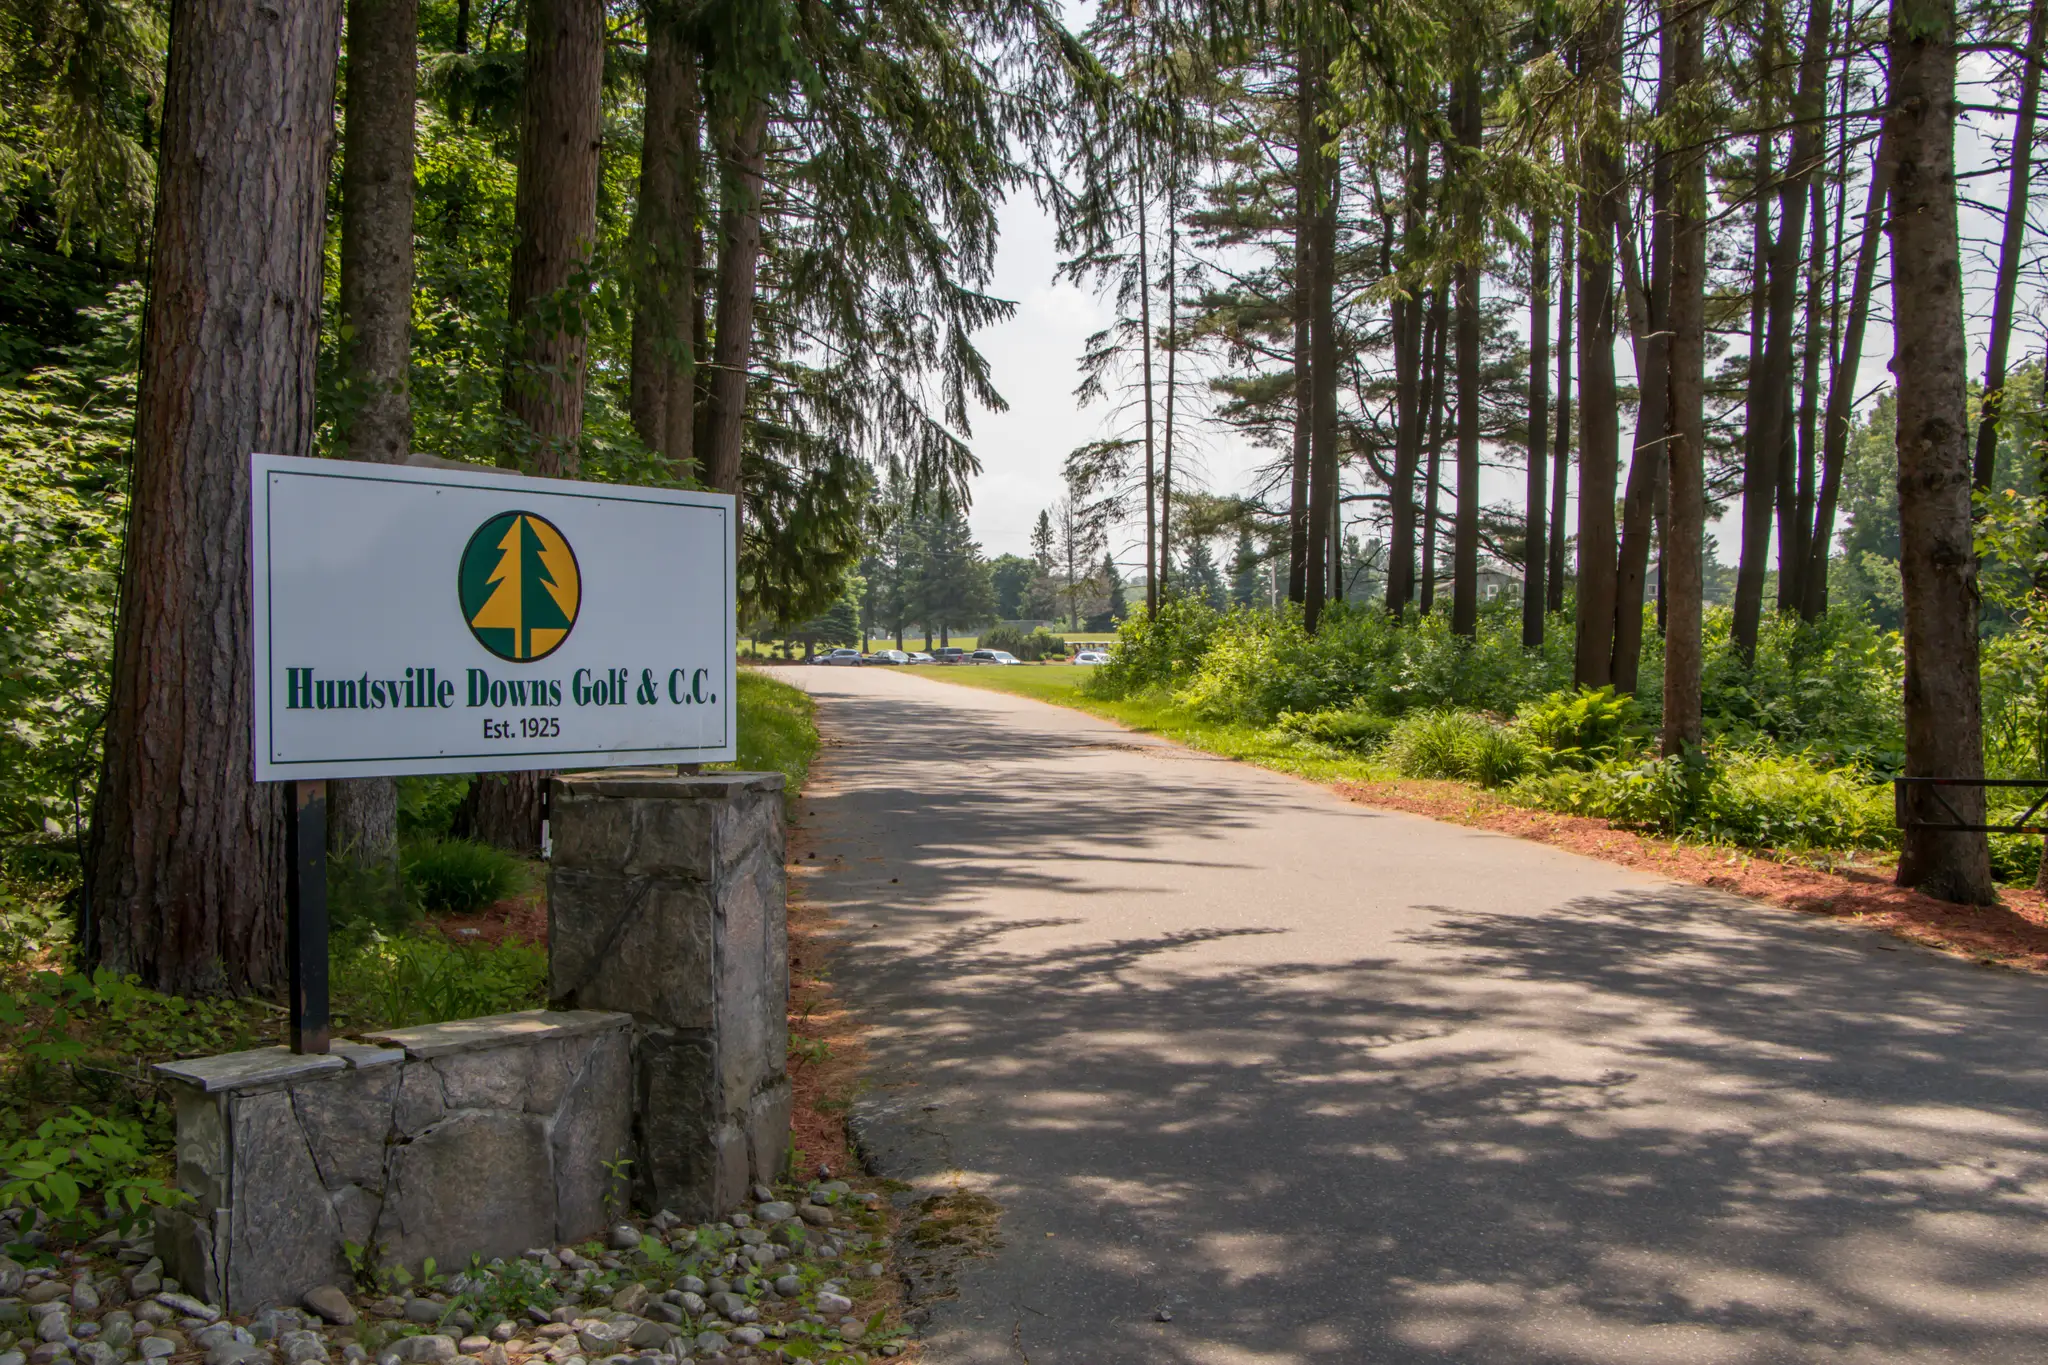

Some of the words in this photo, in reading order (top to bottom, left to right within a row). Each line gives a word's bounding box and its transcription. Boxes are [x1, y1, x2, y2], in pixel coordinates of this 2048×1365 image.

[286, 667, 454, 710] Huntsville
[466, 668, 561, 708] Downs
[572, 668, 628, 706] Golf
[637, 668, 658, 706] &
[669, 668, 717, 705] C.C.
[483, 718, 515, 739] Est.
[520, 717, 560, 738] 1925
